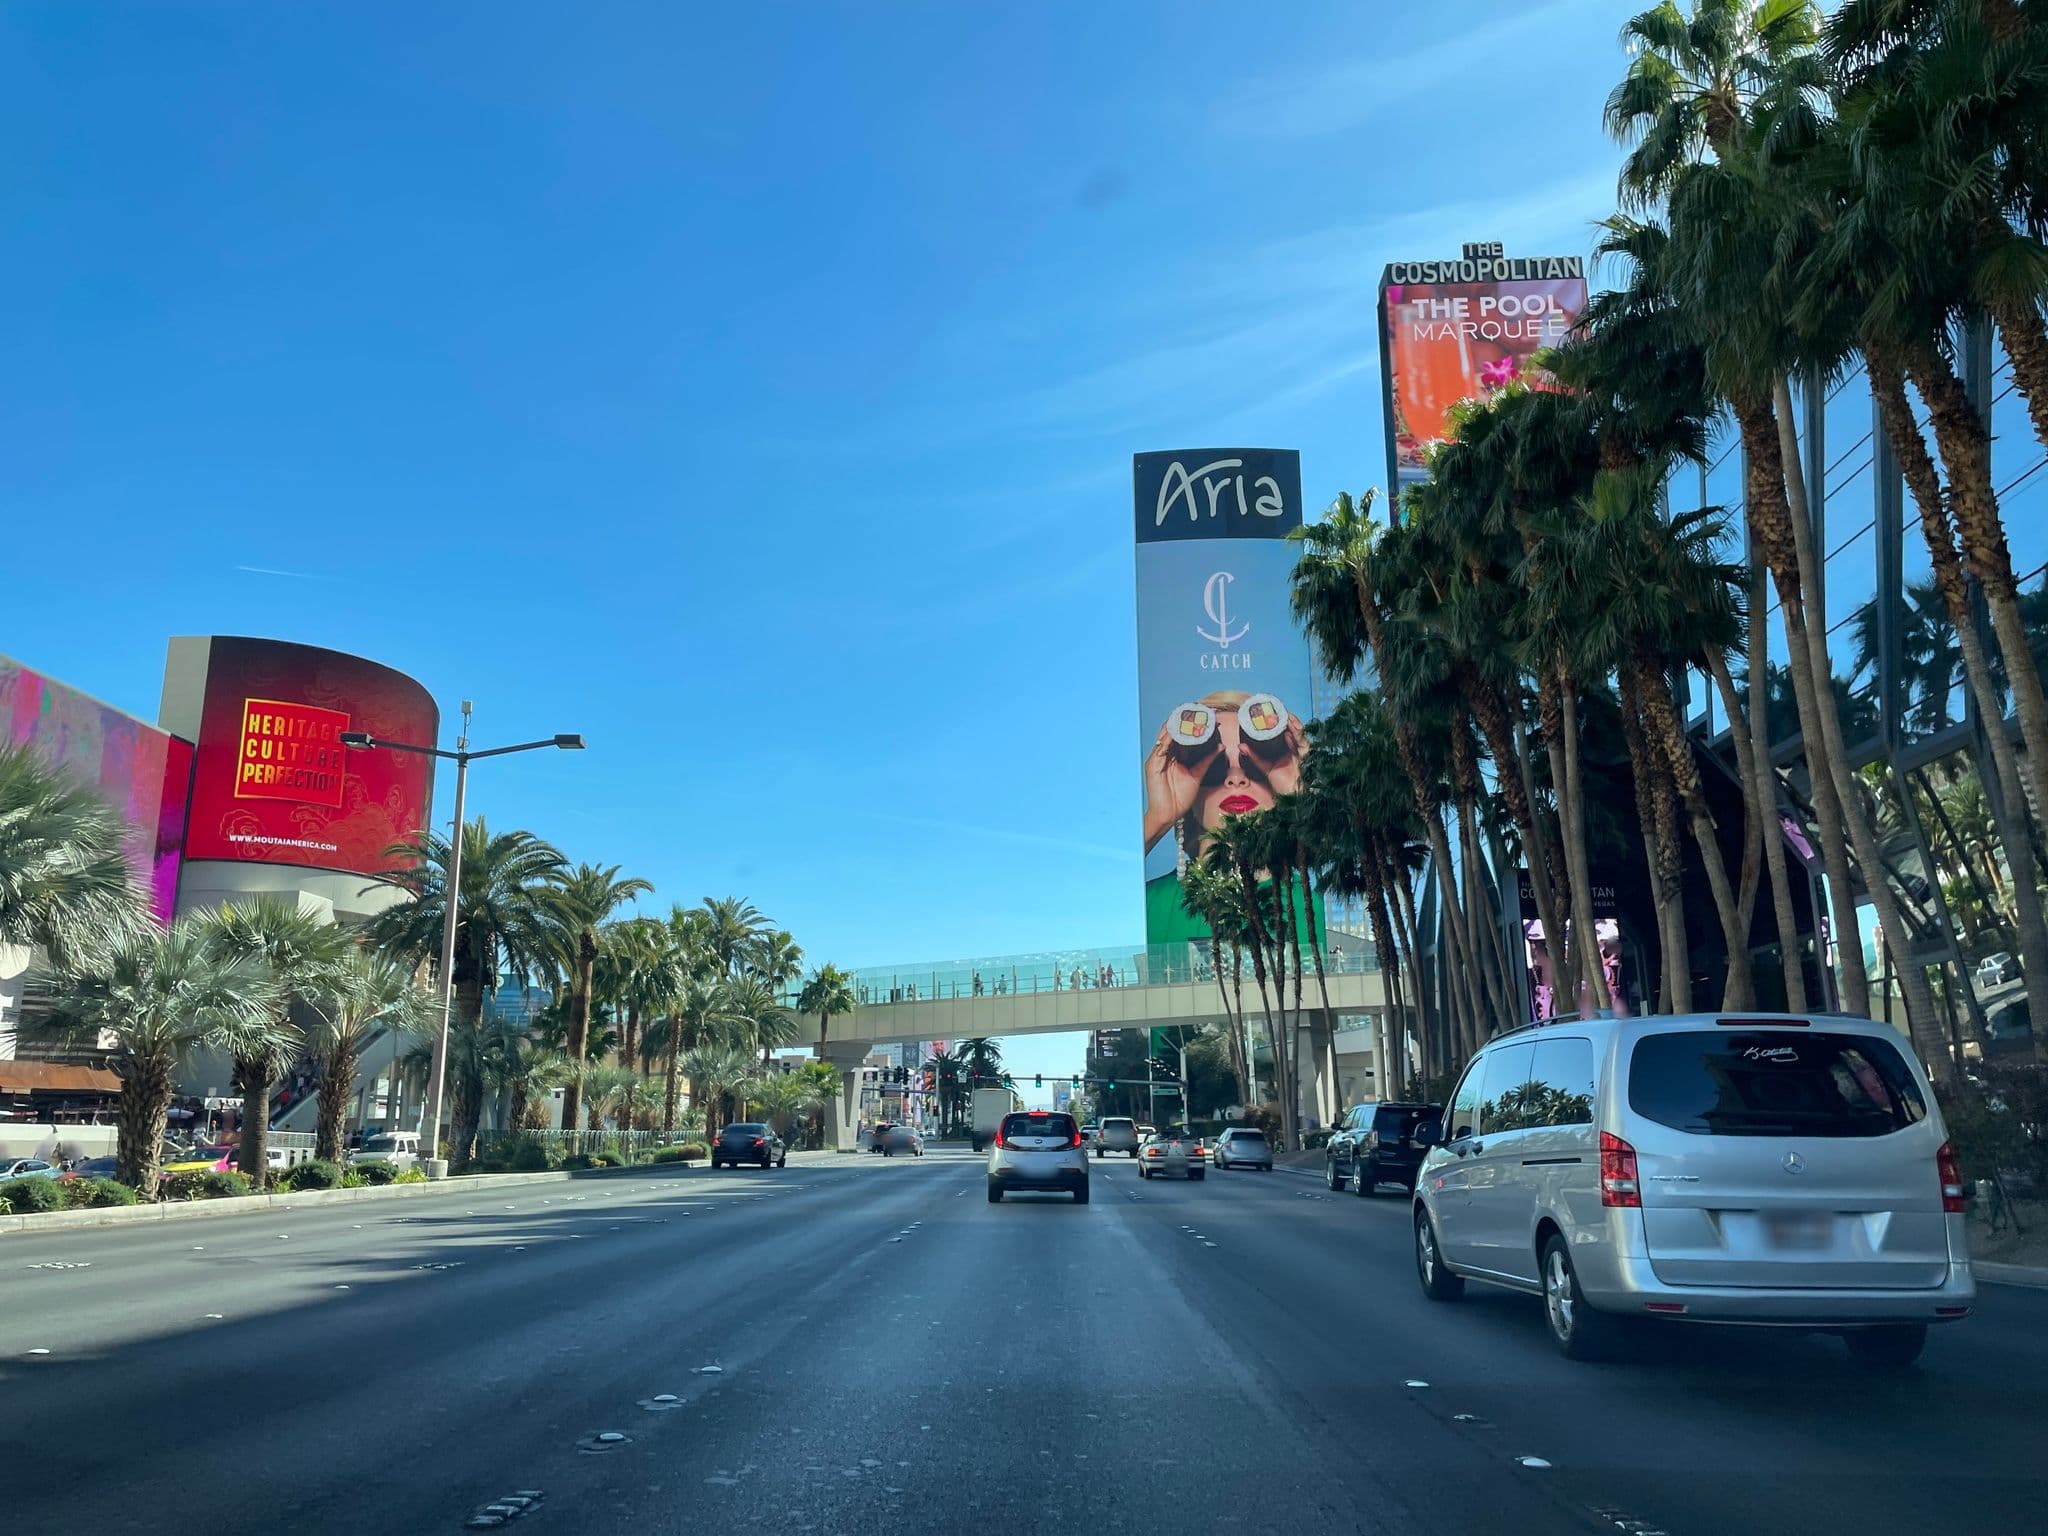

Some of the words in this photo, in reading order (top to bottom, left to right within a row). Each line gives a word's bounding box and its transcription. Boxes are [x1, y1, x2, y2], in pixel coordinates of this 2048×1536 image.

[1467, 242, 1503, 256] THE
[1391, 257, 1581, 284] COSMOPOLITAN
[1412, 298, 1470, 319] THE
[1480, 295, 1563, 317] POOL
[1414, 320, 1569, 341] MARQUEE
[1155, 458, 1284, 527] Aria
[1200, 653, 1251, 670] CATCH
[248, 713, 342, 744] HERITAGE
[246, 738, 341, 769] CULTURE
[243, 763, 338, 791] PERFECTION
[229, 834, 337, 852] WWW.MOUTAIAMERICA.COM
